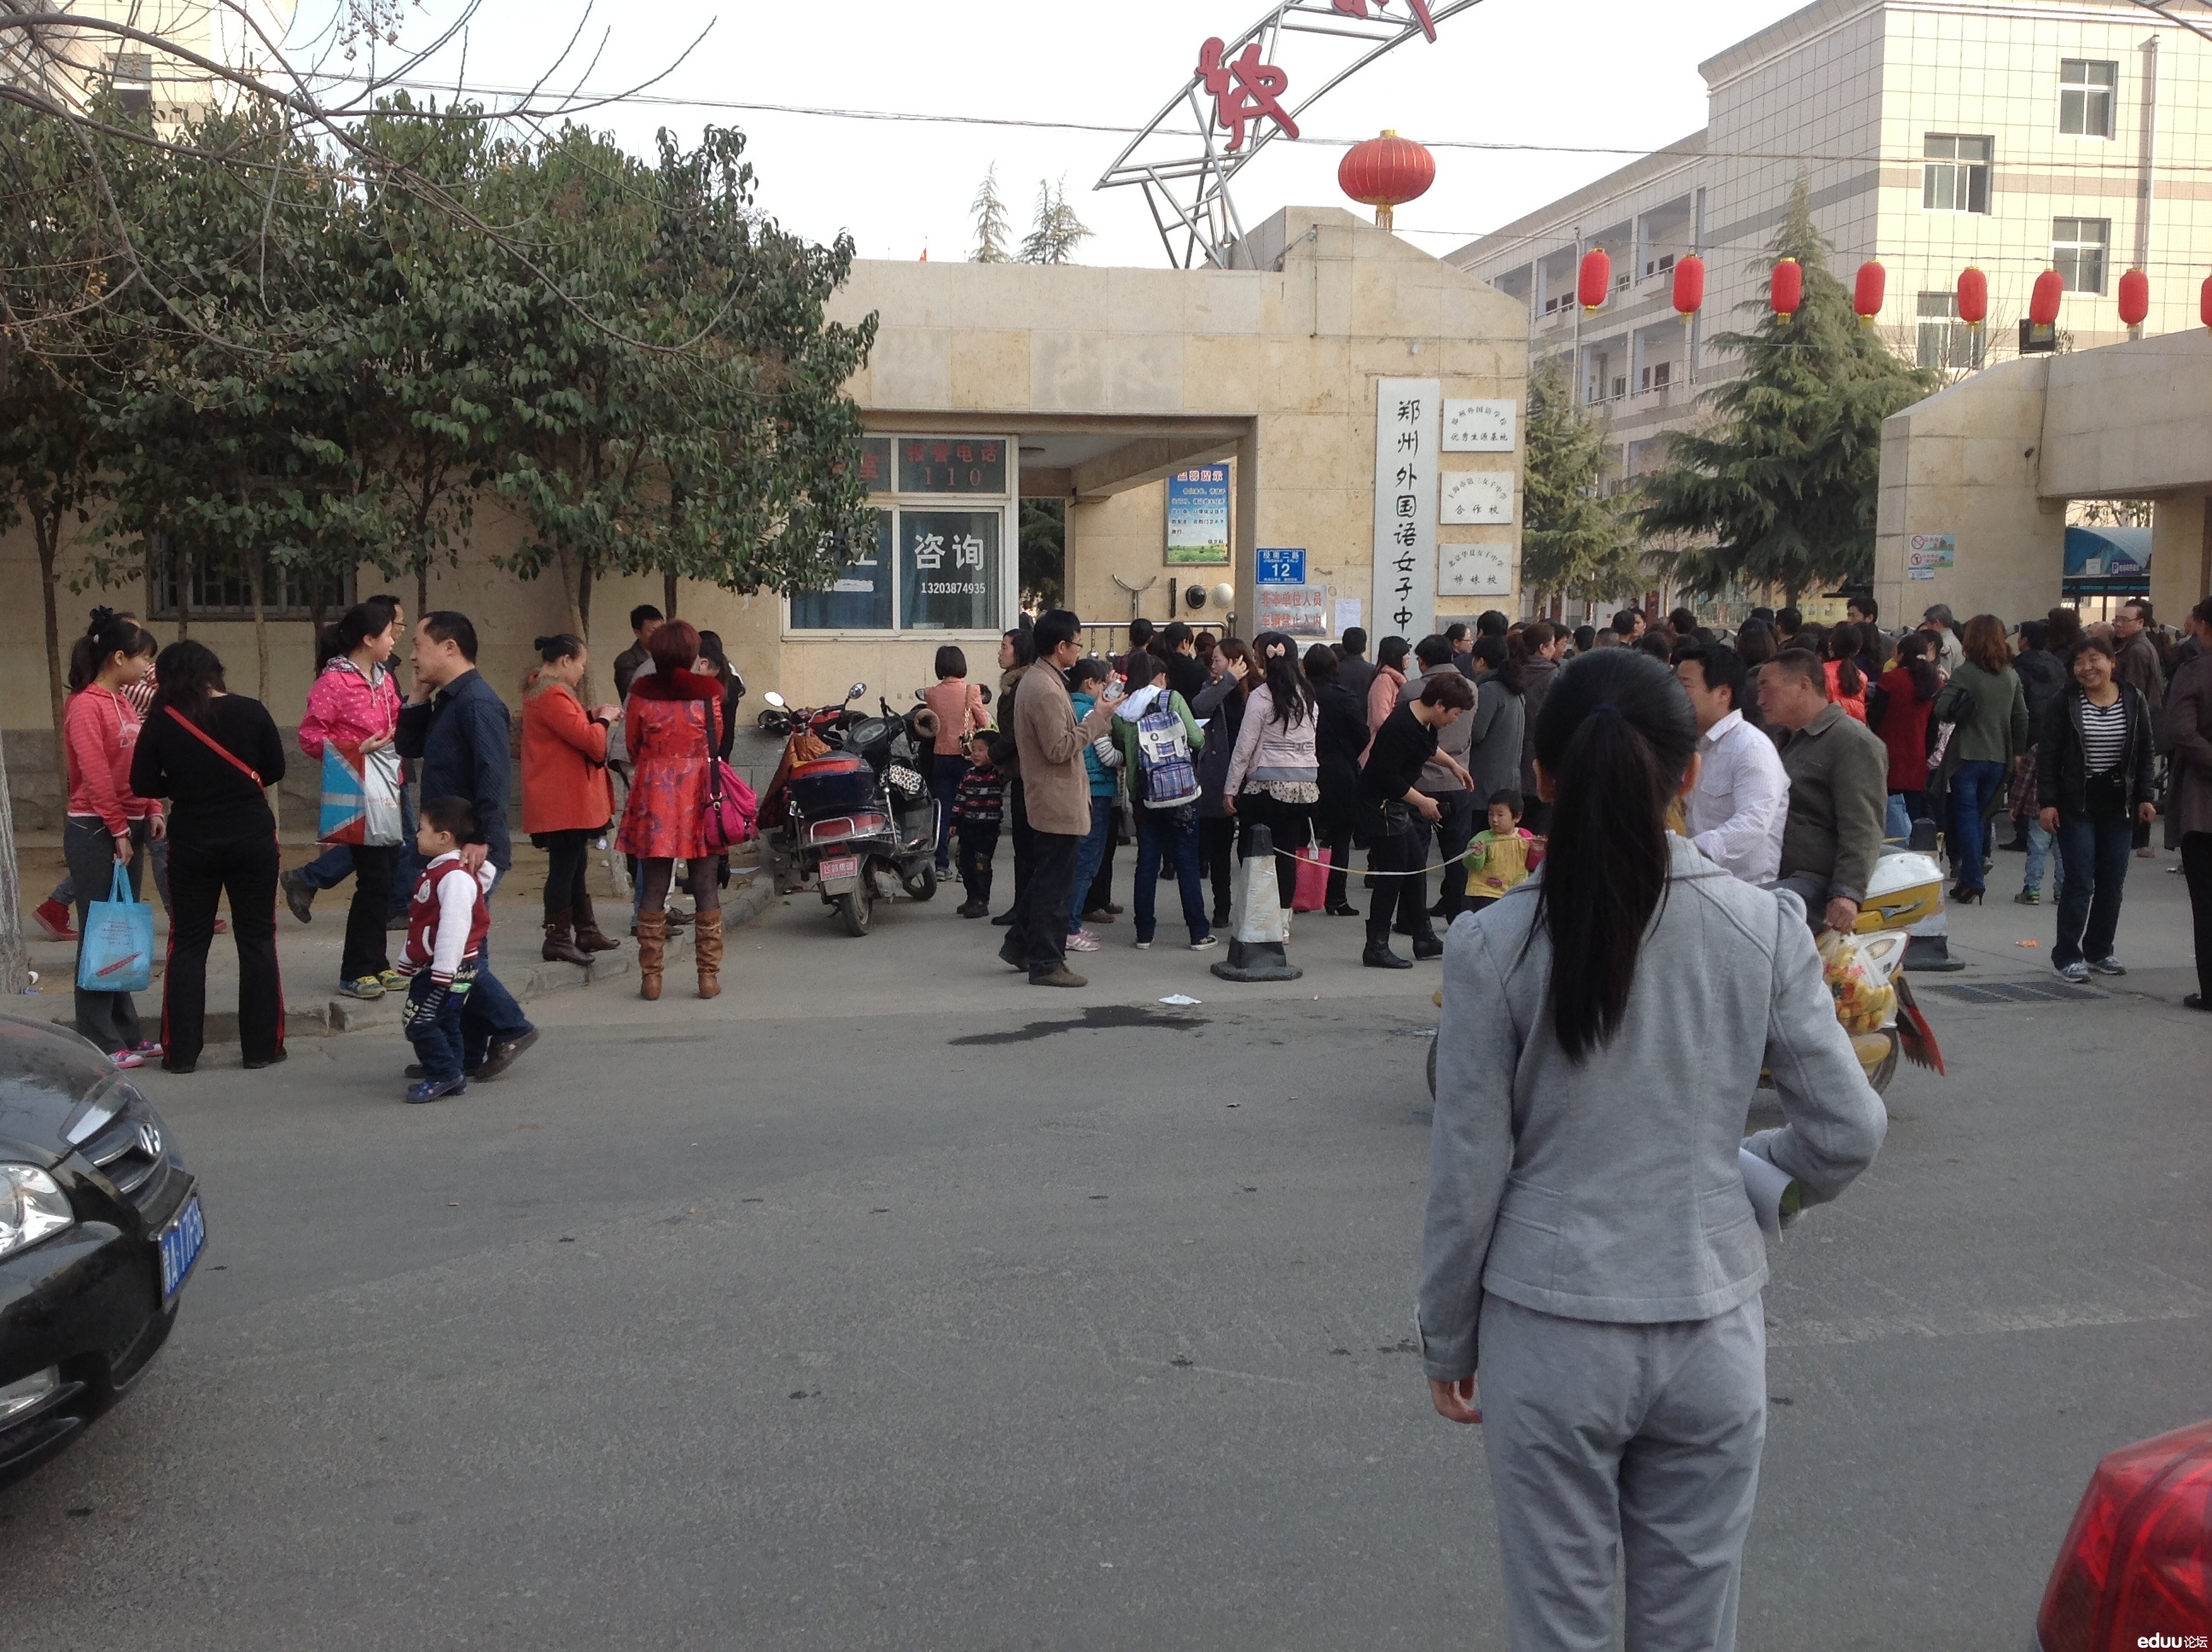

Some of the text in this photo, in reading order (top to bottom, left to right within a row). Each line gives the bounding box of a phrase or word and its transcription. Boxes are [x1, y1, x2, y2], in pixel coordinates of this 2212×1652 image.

[1451, 433, 1508, 441] 优秀生源基地
[908, 443, 998, 462] 报警电话
[924, 468, 981, 486] 110
[1455, 504, 1499, 515] 合作校
[1393, 399, 1421, 648] 郑州外国语女子中
[914, 532, 985, 571] 咨询
[1272, 563, 1290, 577] 12
[921, 582, 986, 594] 13203874935
[1261, 591, 1322, 607] 非本单位人员
[1261, 614, 1321, 628] 车辆禁止入内
